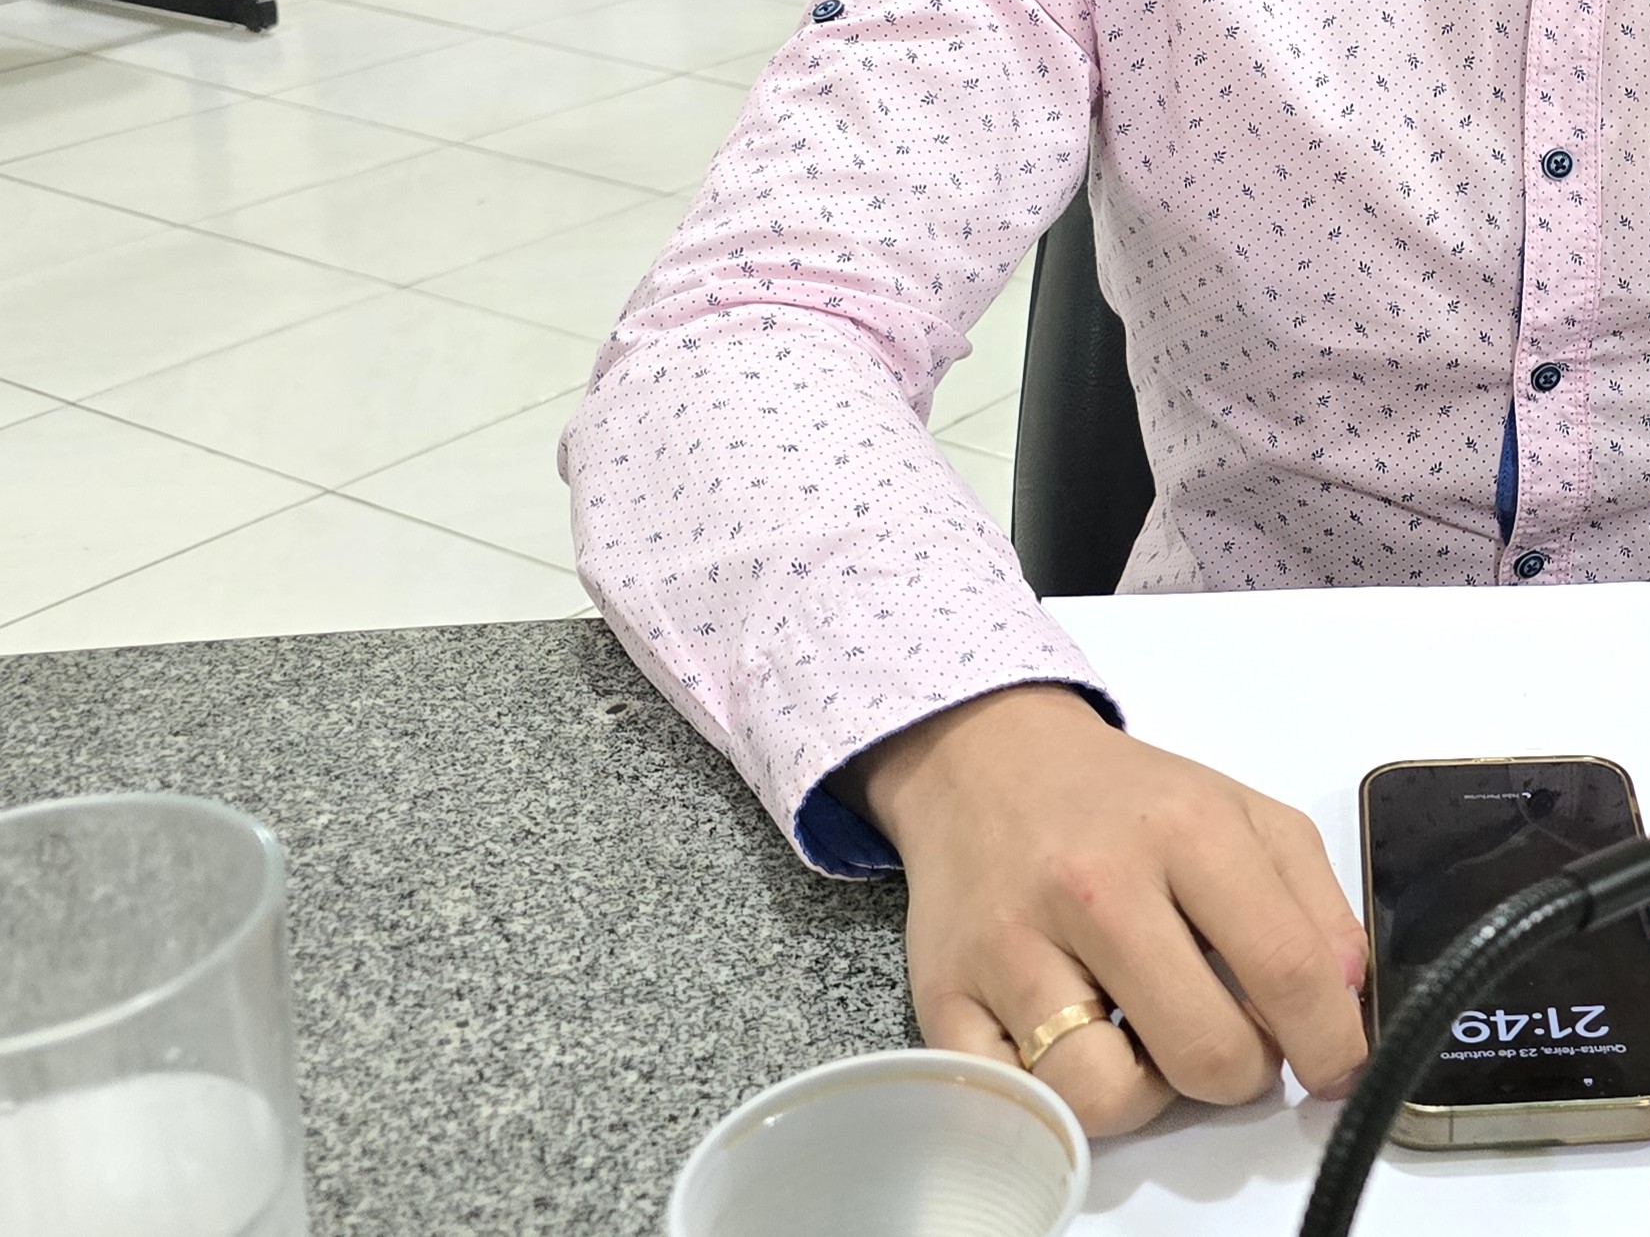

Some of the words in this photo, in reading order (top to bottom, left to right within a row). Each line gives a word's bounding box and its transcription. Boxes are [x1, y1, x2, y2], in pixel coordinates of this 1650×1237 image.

[1451, 1005, 1610, 1044] 21:49
[1440, 1049, 1496, 1061] outubro
[1498, 1048, 1517, 1059] de
[1519, 1047, 1539, 1058] 23
[1540, 1043, 1627, 1055] Quinta-feira,
